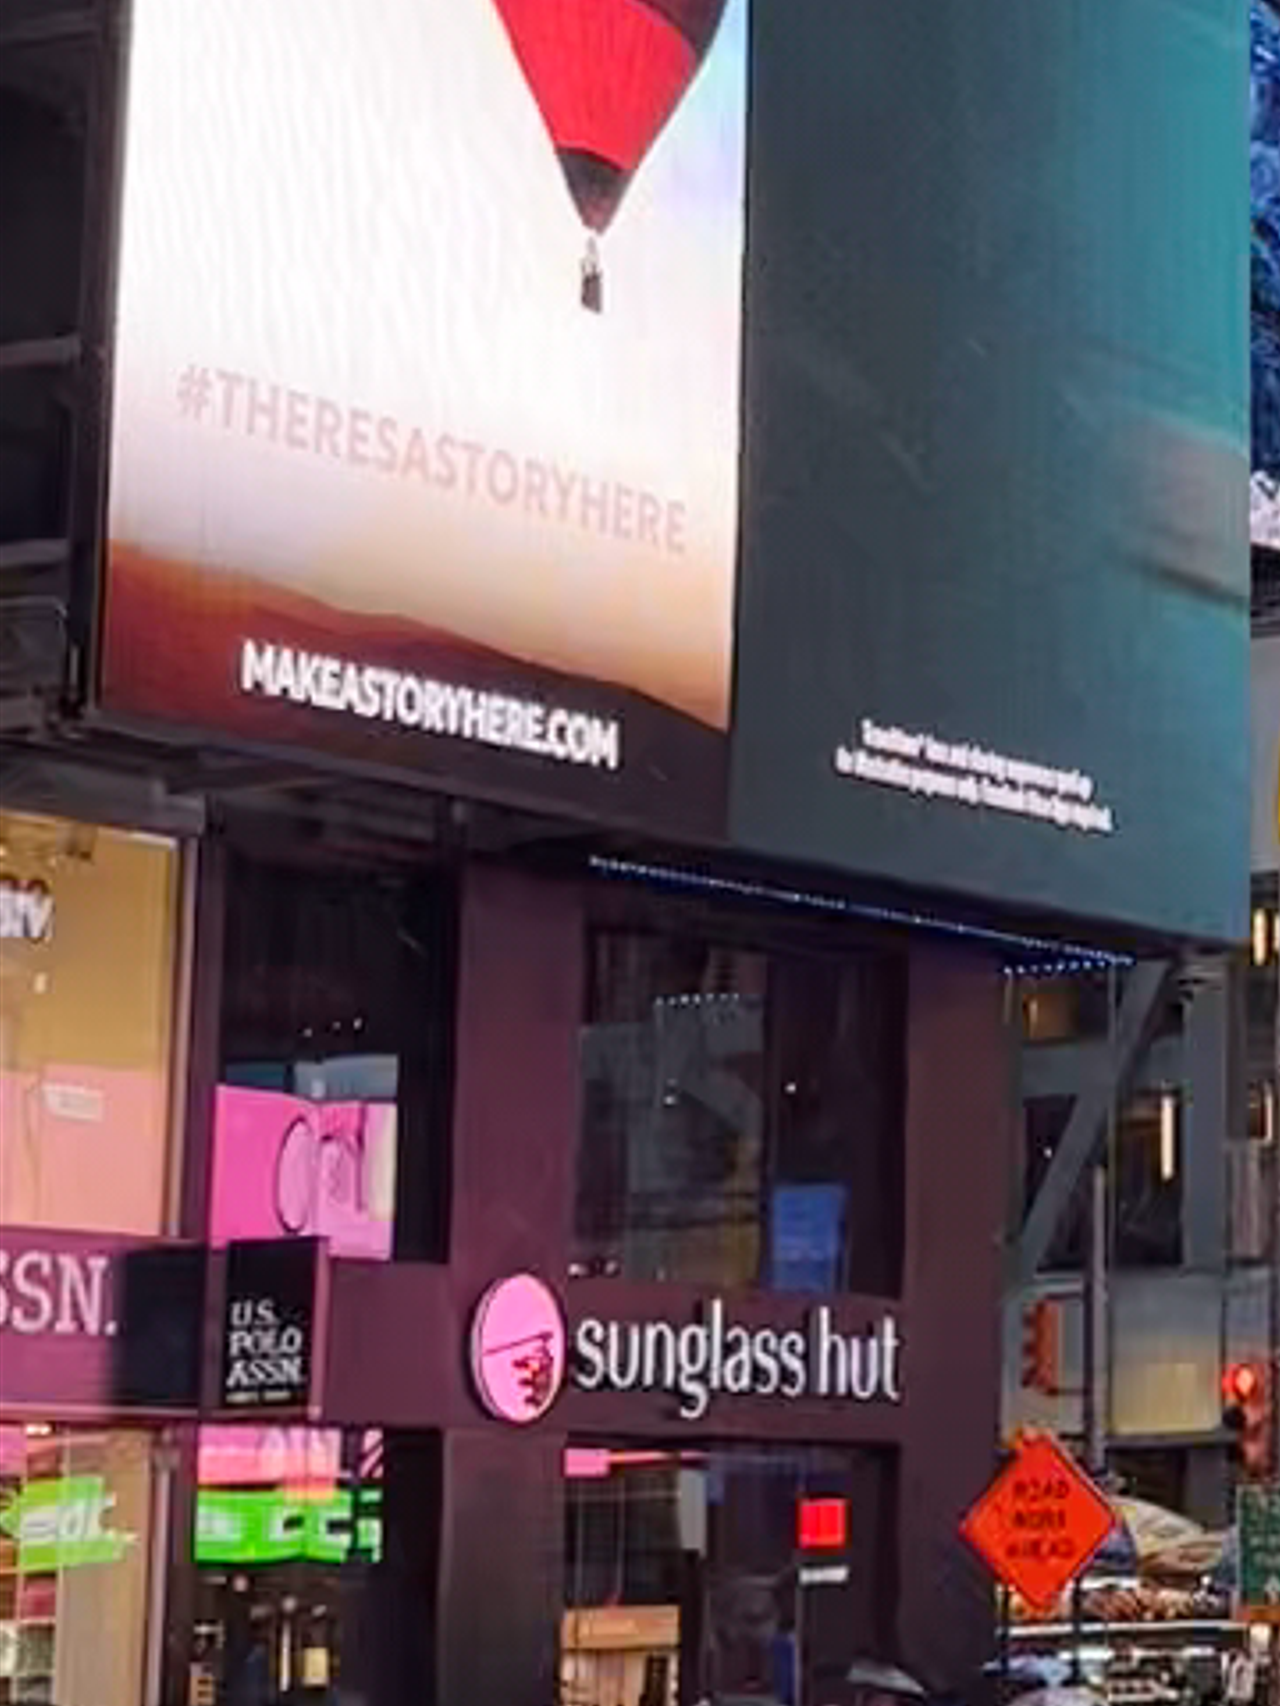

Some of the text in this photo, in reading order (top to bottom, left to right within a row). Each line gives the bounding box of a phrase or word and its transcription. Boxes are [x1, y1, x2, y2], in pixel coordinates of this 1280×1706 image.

[174, 363, 689, 558] #THERESASTORYHERE
[240, 637, 621, 771] MAKEASTORYHERE.COM
[228, 1324, 304, 1358] POLO
[575, 1298, 900, 1418] sunglass hut
